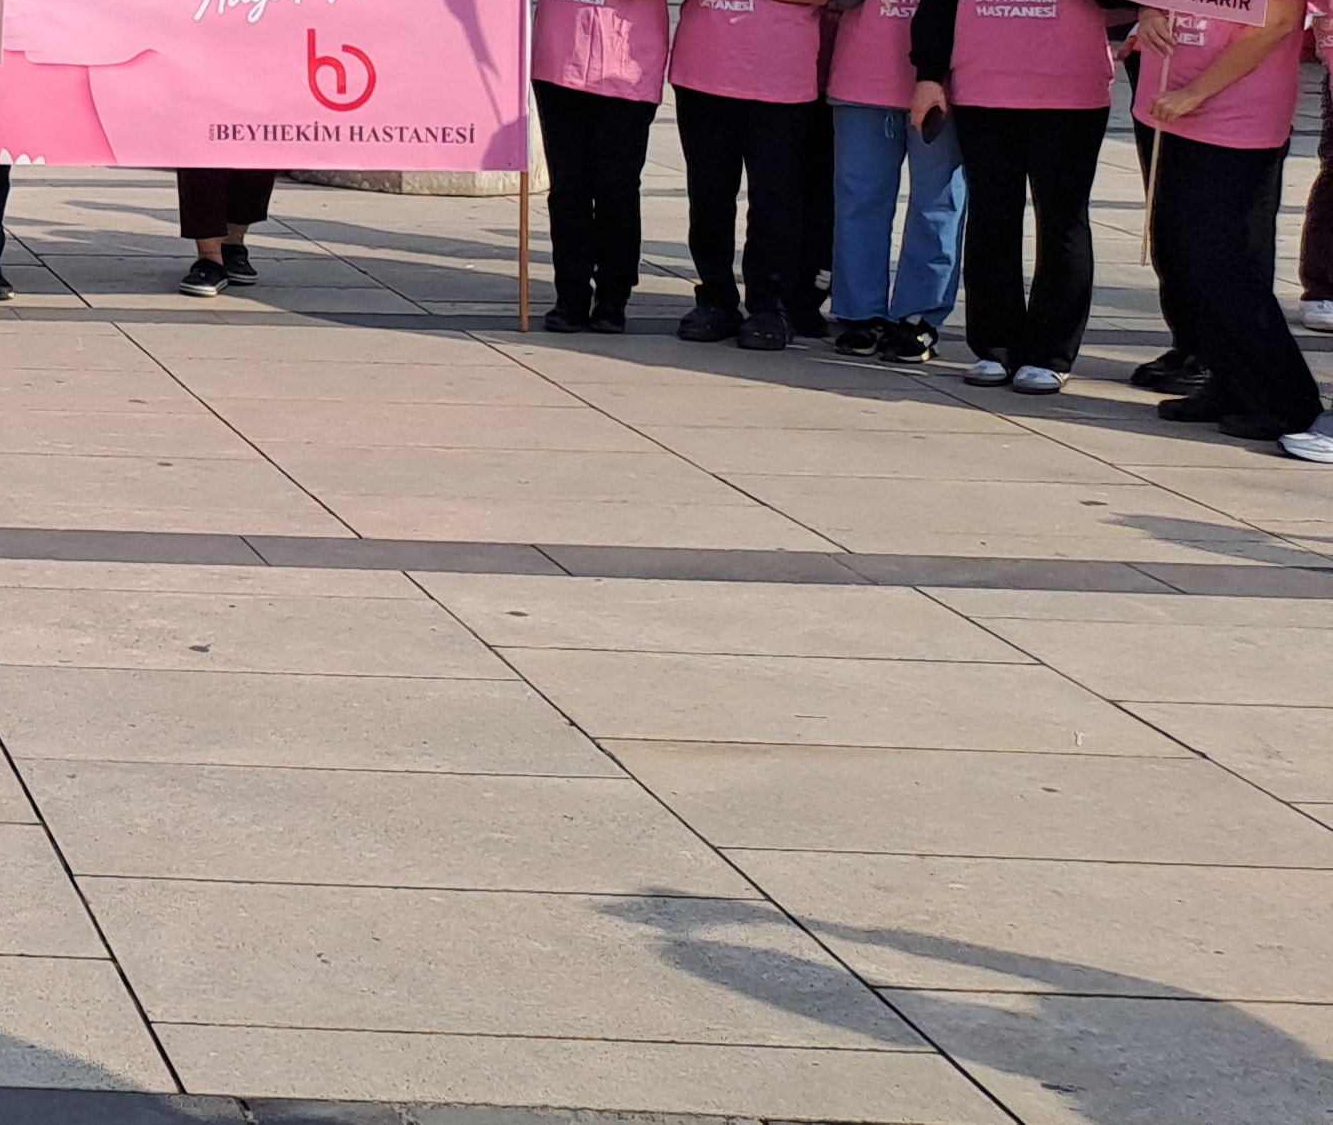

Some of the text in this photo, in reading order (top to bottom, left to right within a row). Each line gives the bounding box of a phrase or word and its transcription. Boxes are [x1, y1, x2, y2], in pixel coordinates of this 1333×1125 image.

[976, 5, 1056, 18] HASTANESİ
[216, 121, 476, 144] BEYHEKİM HASTANESİ
